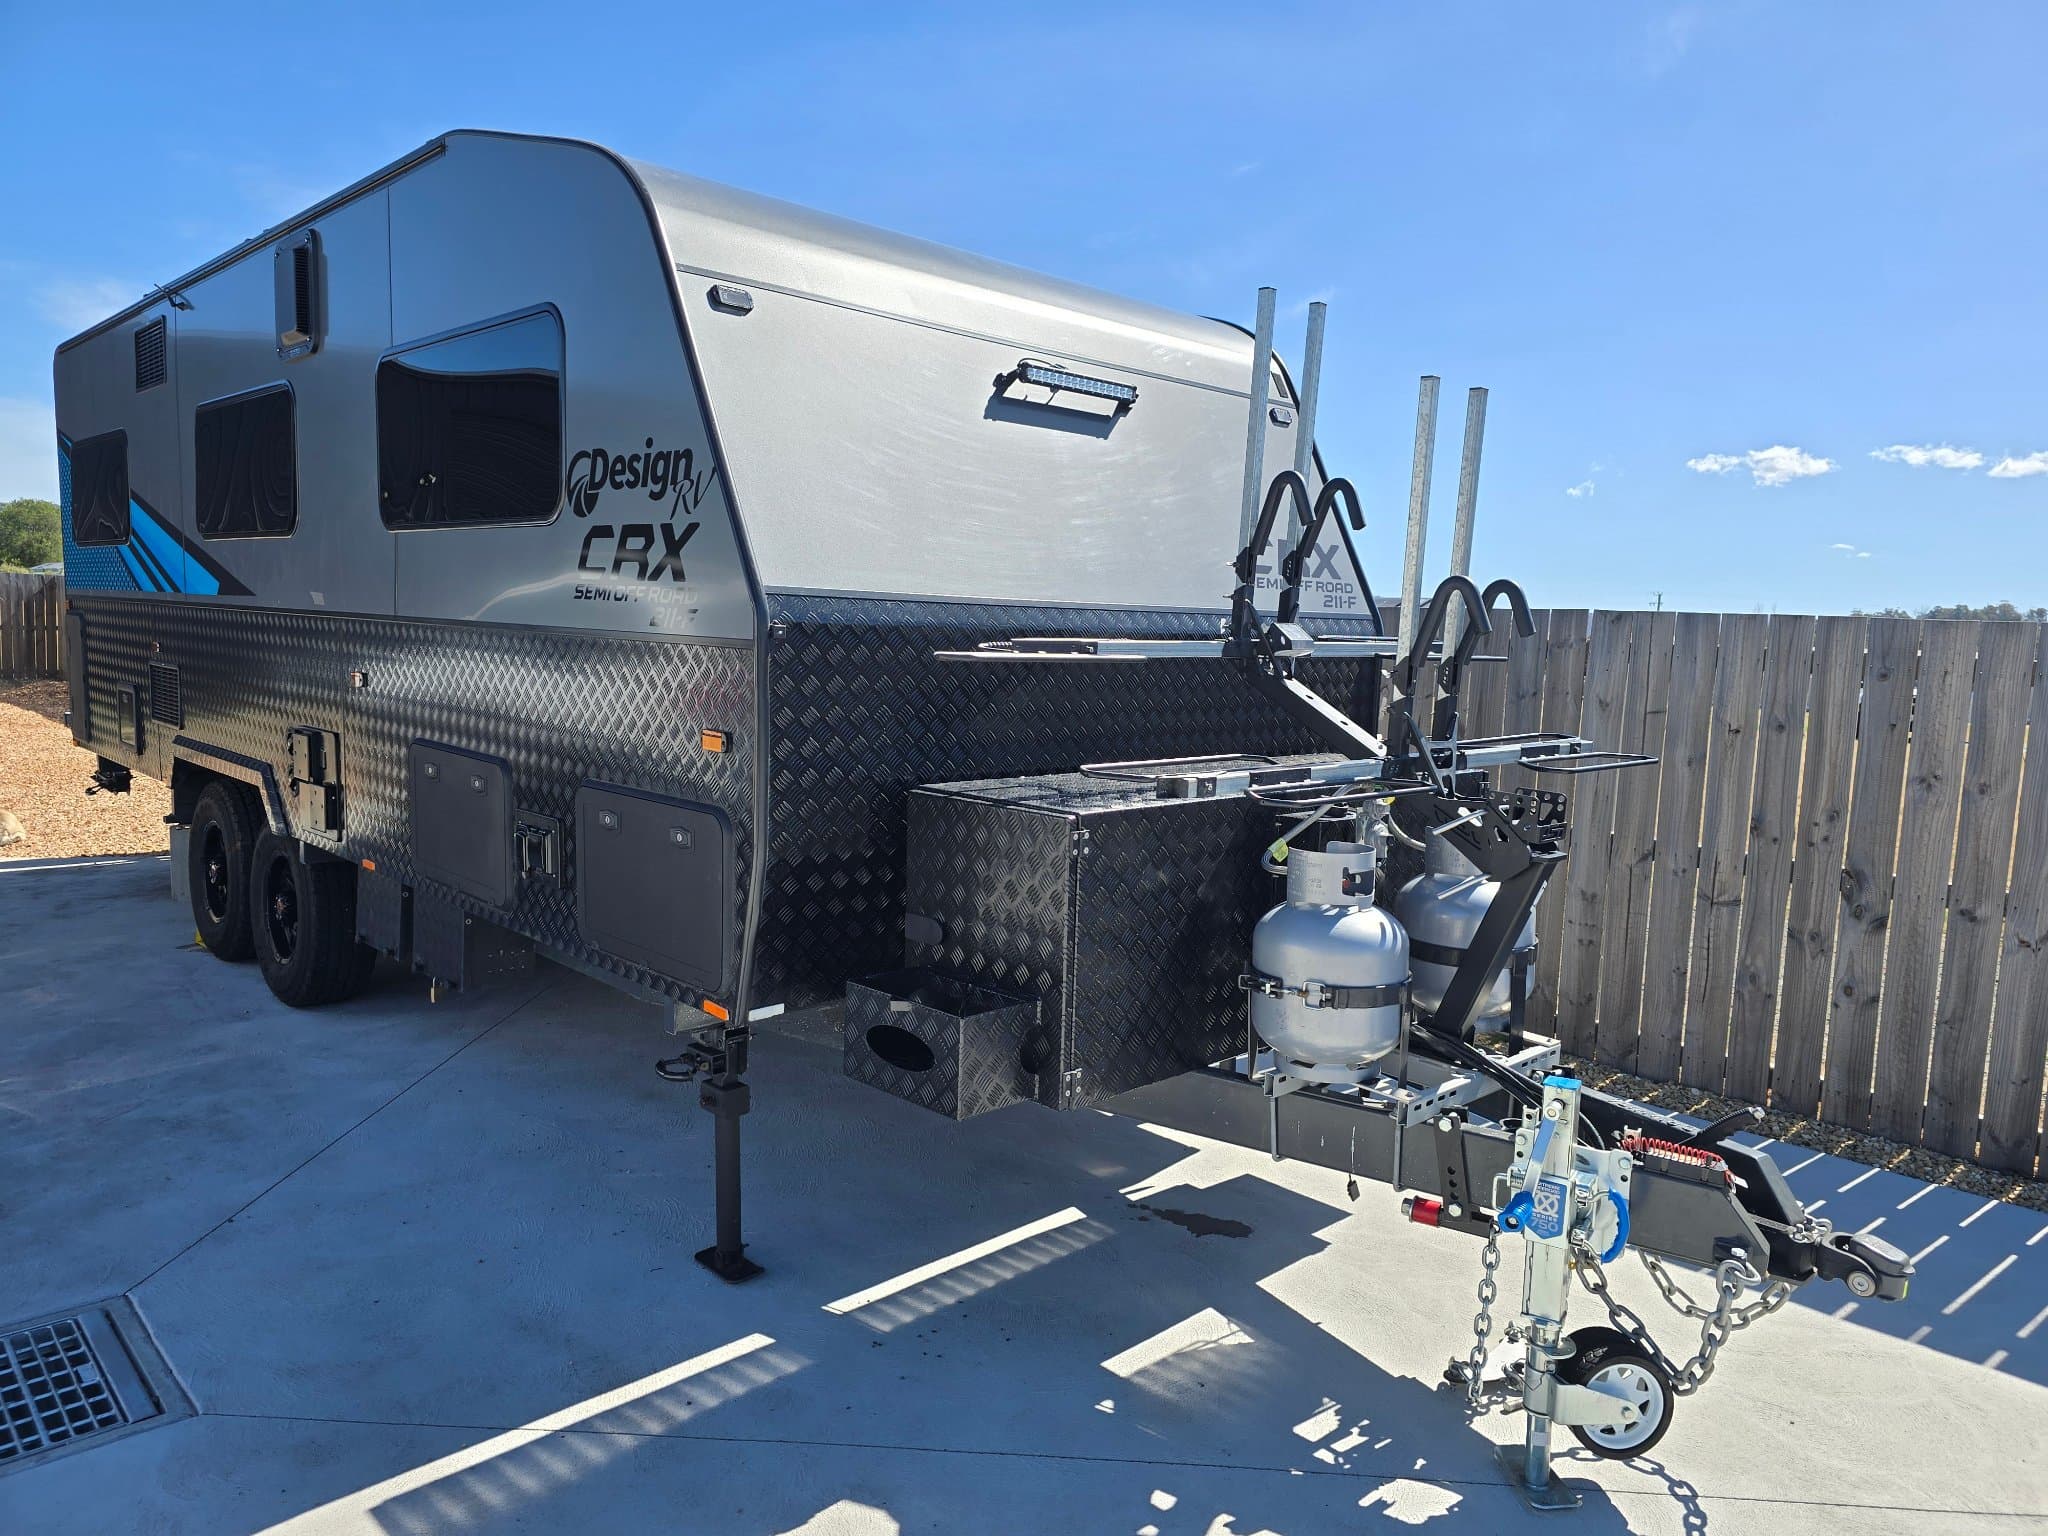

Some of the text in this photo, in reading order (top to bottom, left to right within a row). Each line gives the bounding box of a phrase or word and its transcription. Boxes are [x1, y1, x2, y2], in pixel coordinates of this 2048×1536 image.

[588, 437, 716, 520] Design RV
[577, 522, 700, 582] CRX
[574, 584, 612, 601] SEMI
[1315, 581, 1354, 594] ROAD
[1323, 595, 1357, 609] 211-F
[1530, 1216, 1559, 1232] 750
